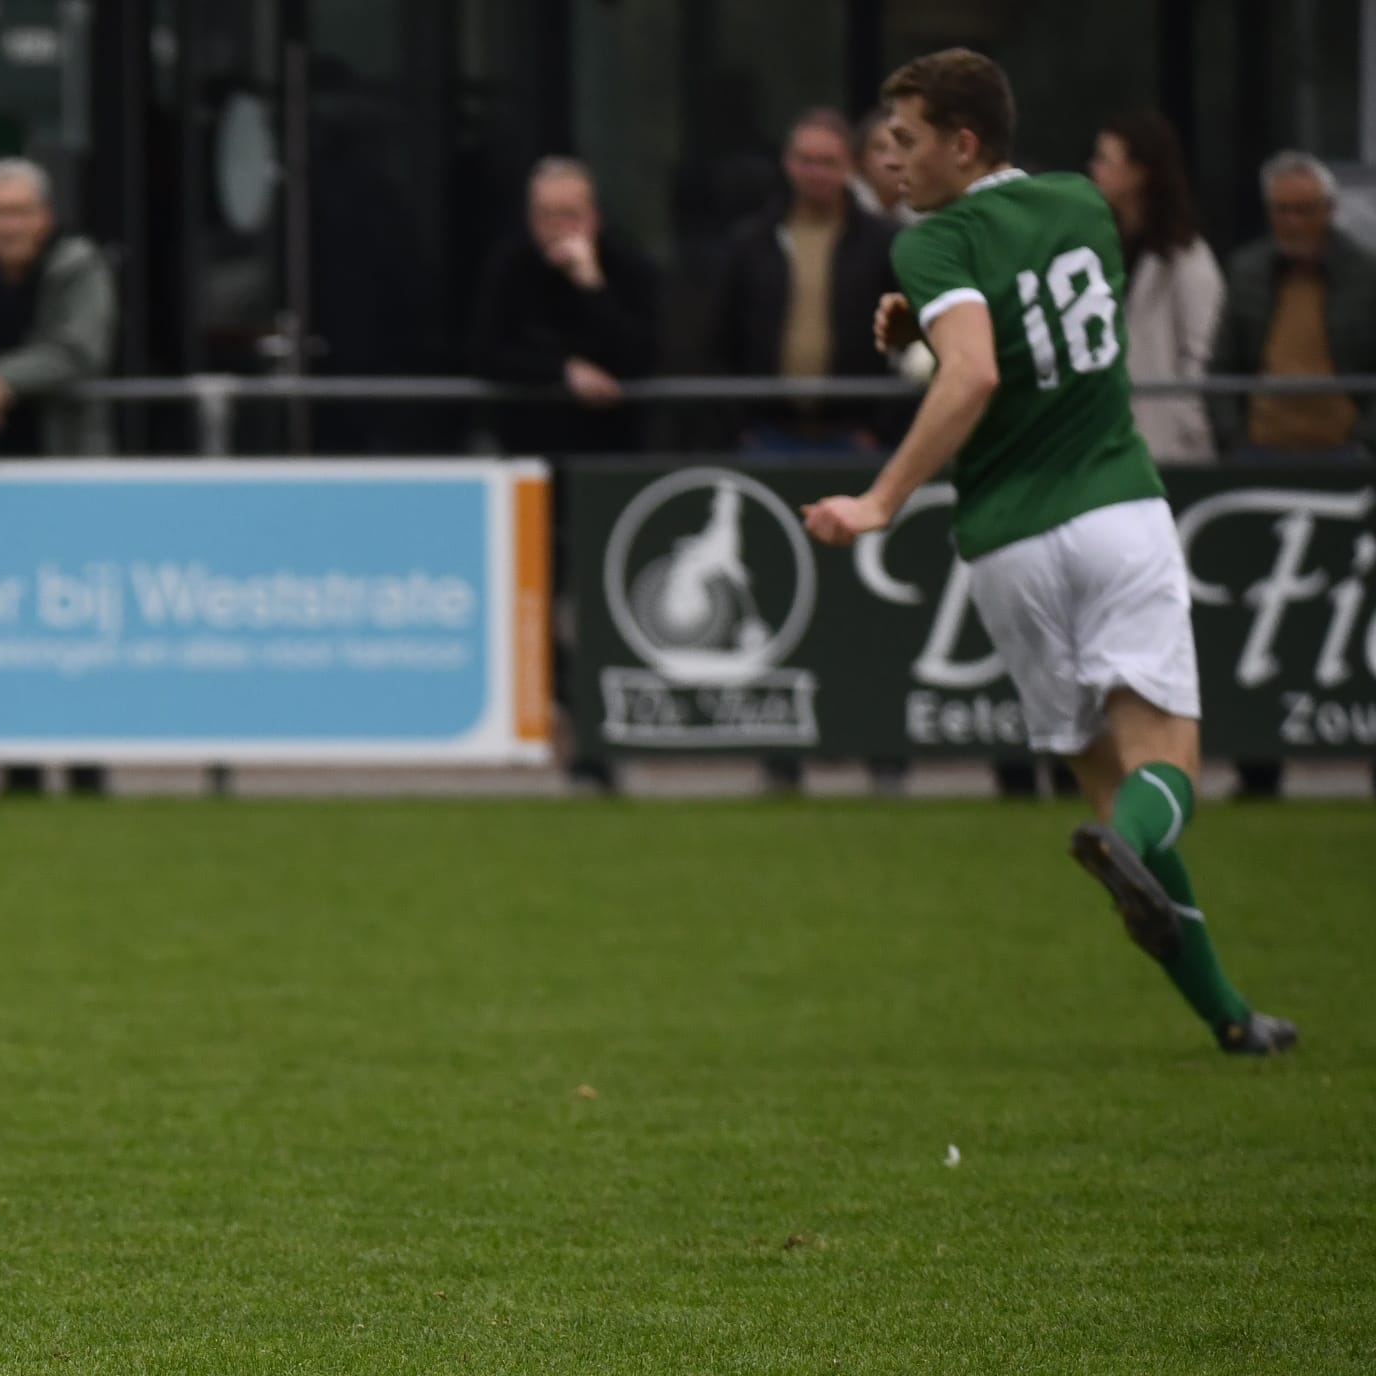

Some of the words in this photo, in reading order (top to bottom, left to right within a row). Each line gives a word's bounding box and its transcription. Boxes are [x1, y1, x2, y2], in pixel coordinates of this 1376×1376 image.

[1016, 246, 1120, 390] 18
[37, 561, 122, 644] bij
[131, 562, 475, 630] Weststrate
[1278, 690, 1376, 745] Zou
